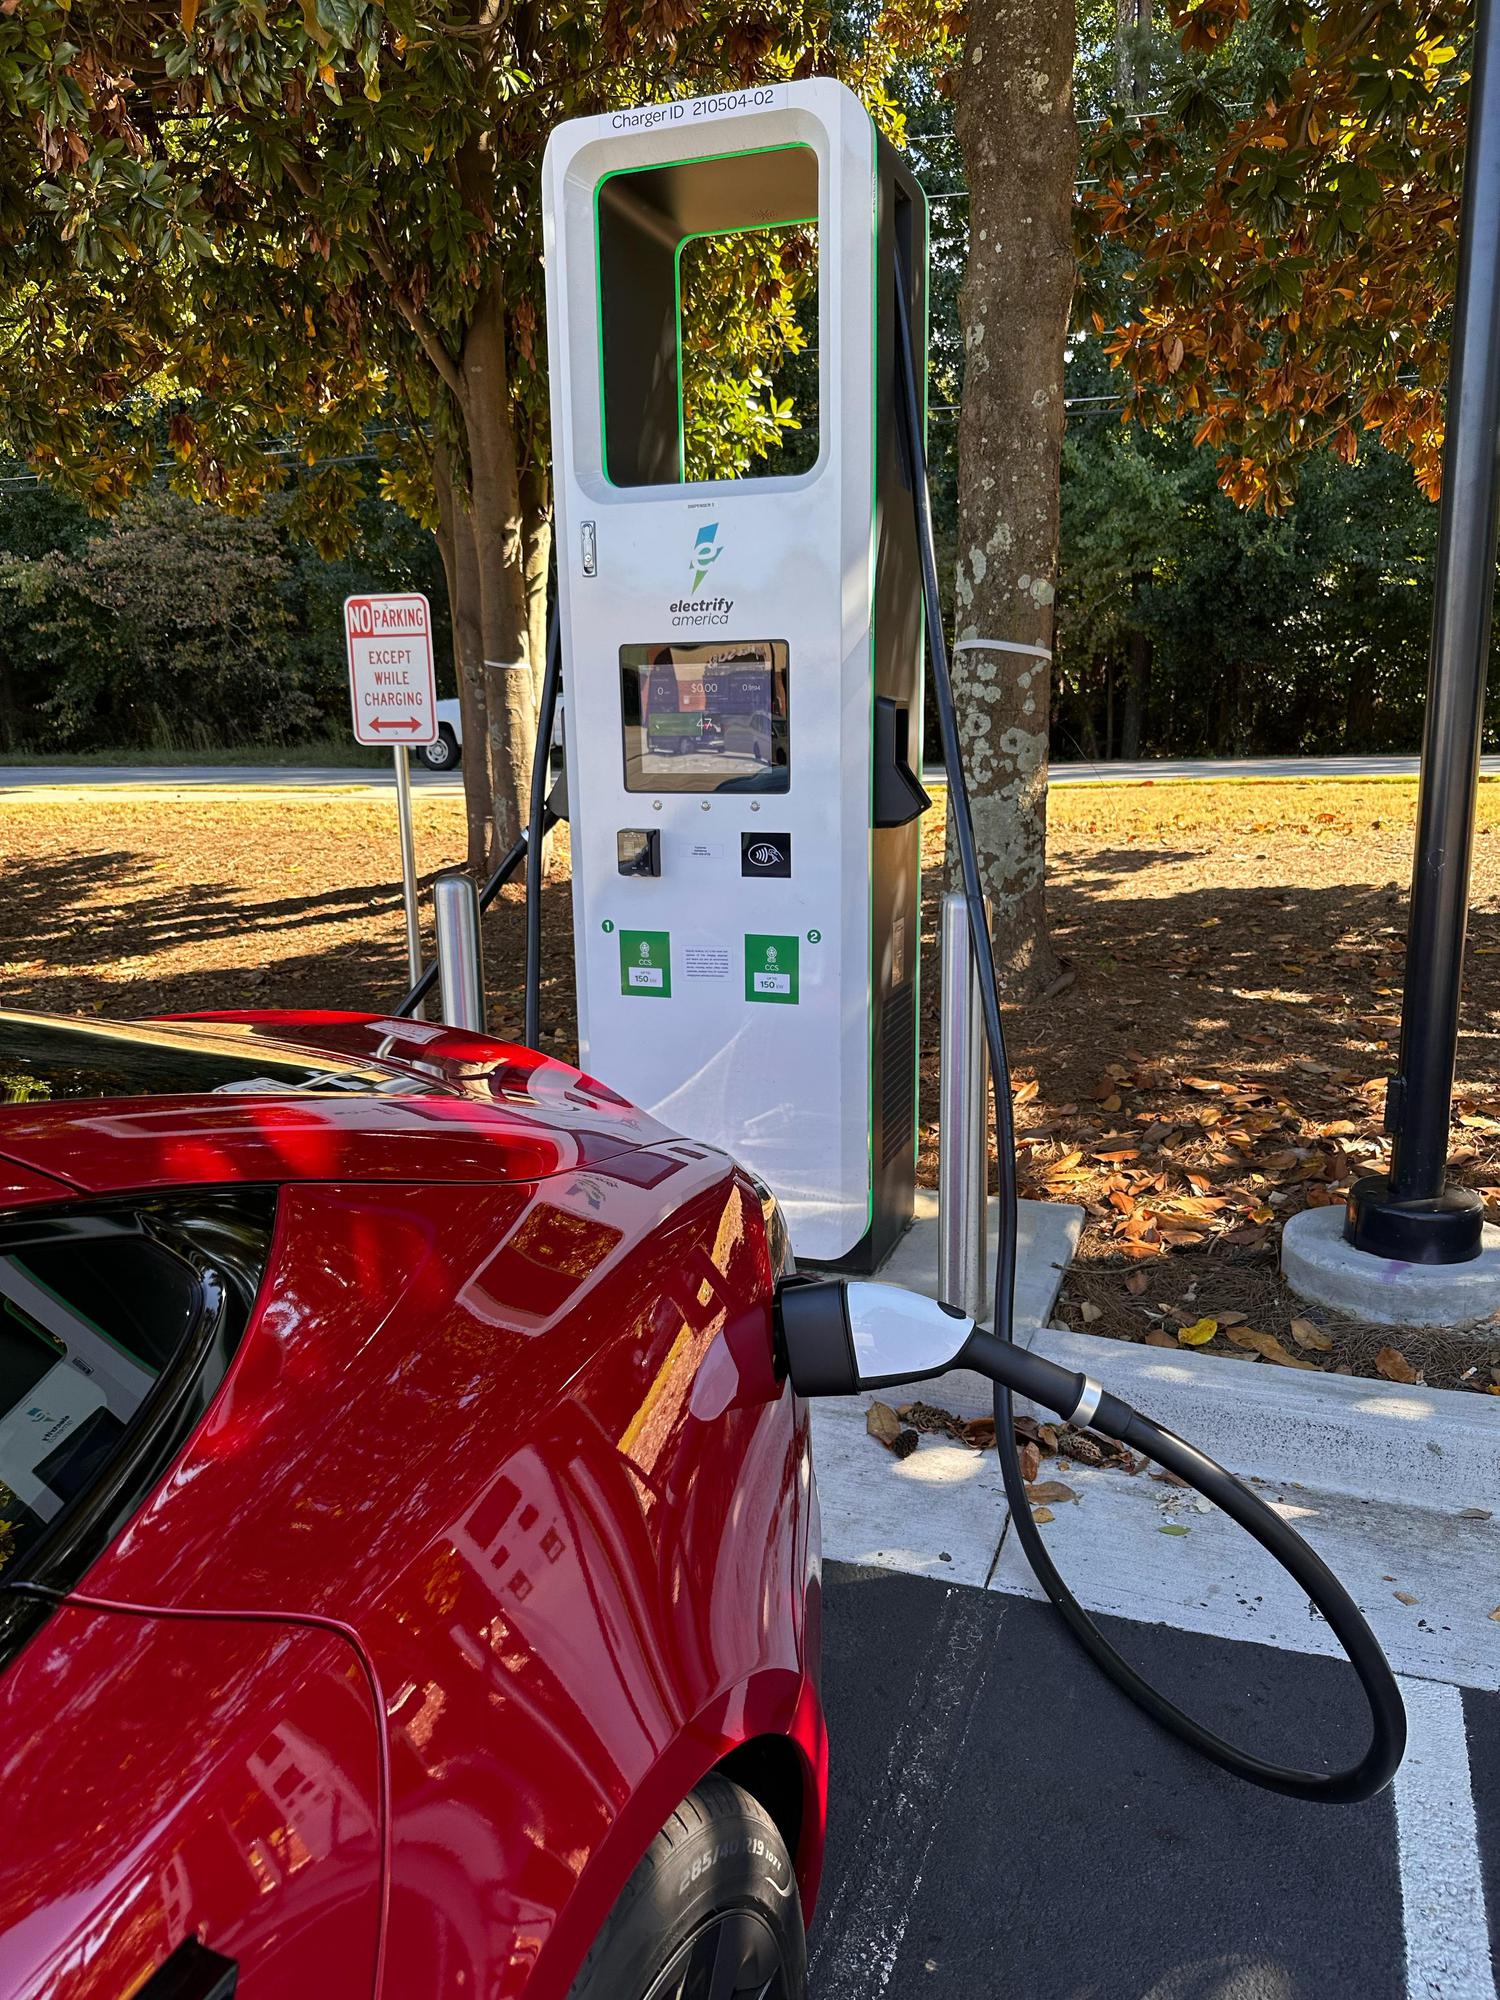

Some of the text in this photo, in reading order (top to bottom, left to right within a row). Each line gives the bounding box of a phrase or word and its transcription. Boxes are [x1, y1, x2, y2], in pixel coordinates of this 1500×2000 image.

[612, 89, 774, 129] Charger ID 210504-02
[669, 598, 734, 614] electrify
[350, 605, 424, 633] NO PARKING
[671, 613, 729, 626] america
[368, 650, 412, 665] EXCEPT
[374, 671, 409, 686] WHILE
[691, 683, 718, 693] $0.00
[364, 691, 423, 707] CHARGING
[696, 718, 713, 730] 47
[638, 958, 652, 966] CCS
[764, 963, 779, 971] CCS
[635, 975, 649, 983] 150
[760, 981, 775, 989] 150
